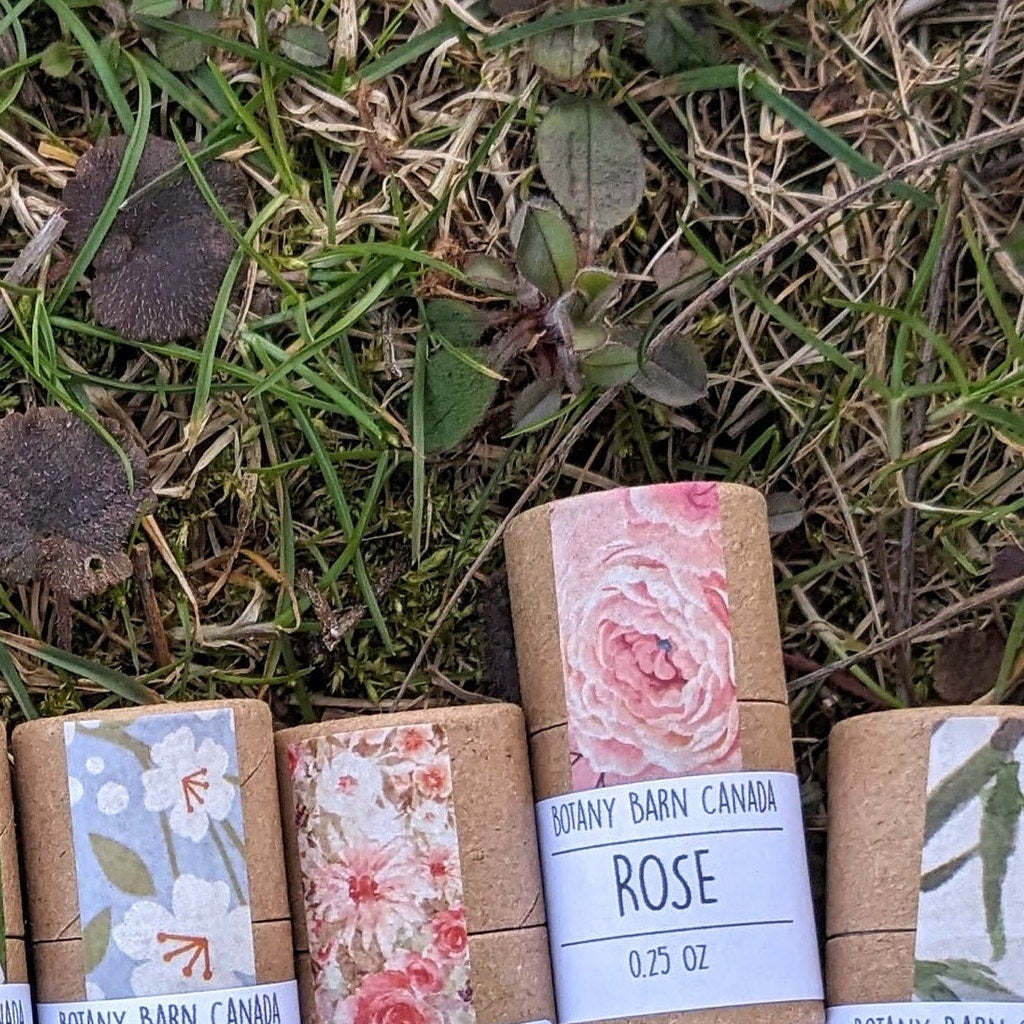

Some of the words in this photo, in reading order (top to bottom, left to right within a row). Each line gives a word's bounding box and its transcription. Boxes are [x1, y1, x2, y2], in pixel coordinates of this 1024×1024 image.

[551, 798, 617, 838] BOTANY
[628, 787, 689, 824] BARN
[701, 778, 778, 816] CANADA
[611, 848, 719, 918] ROSE
[628, 945, 671, 979] 0.25
[681, 944, 710, 972] OZ
